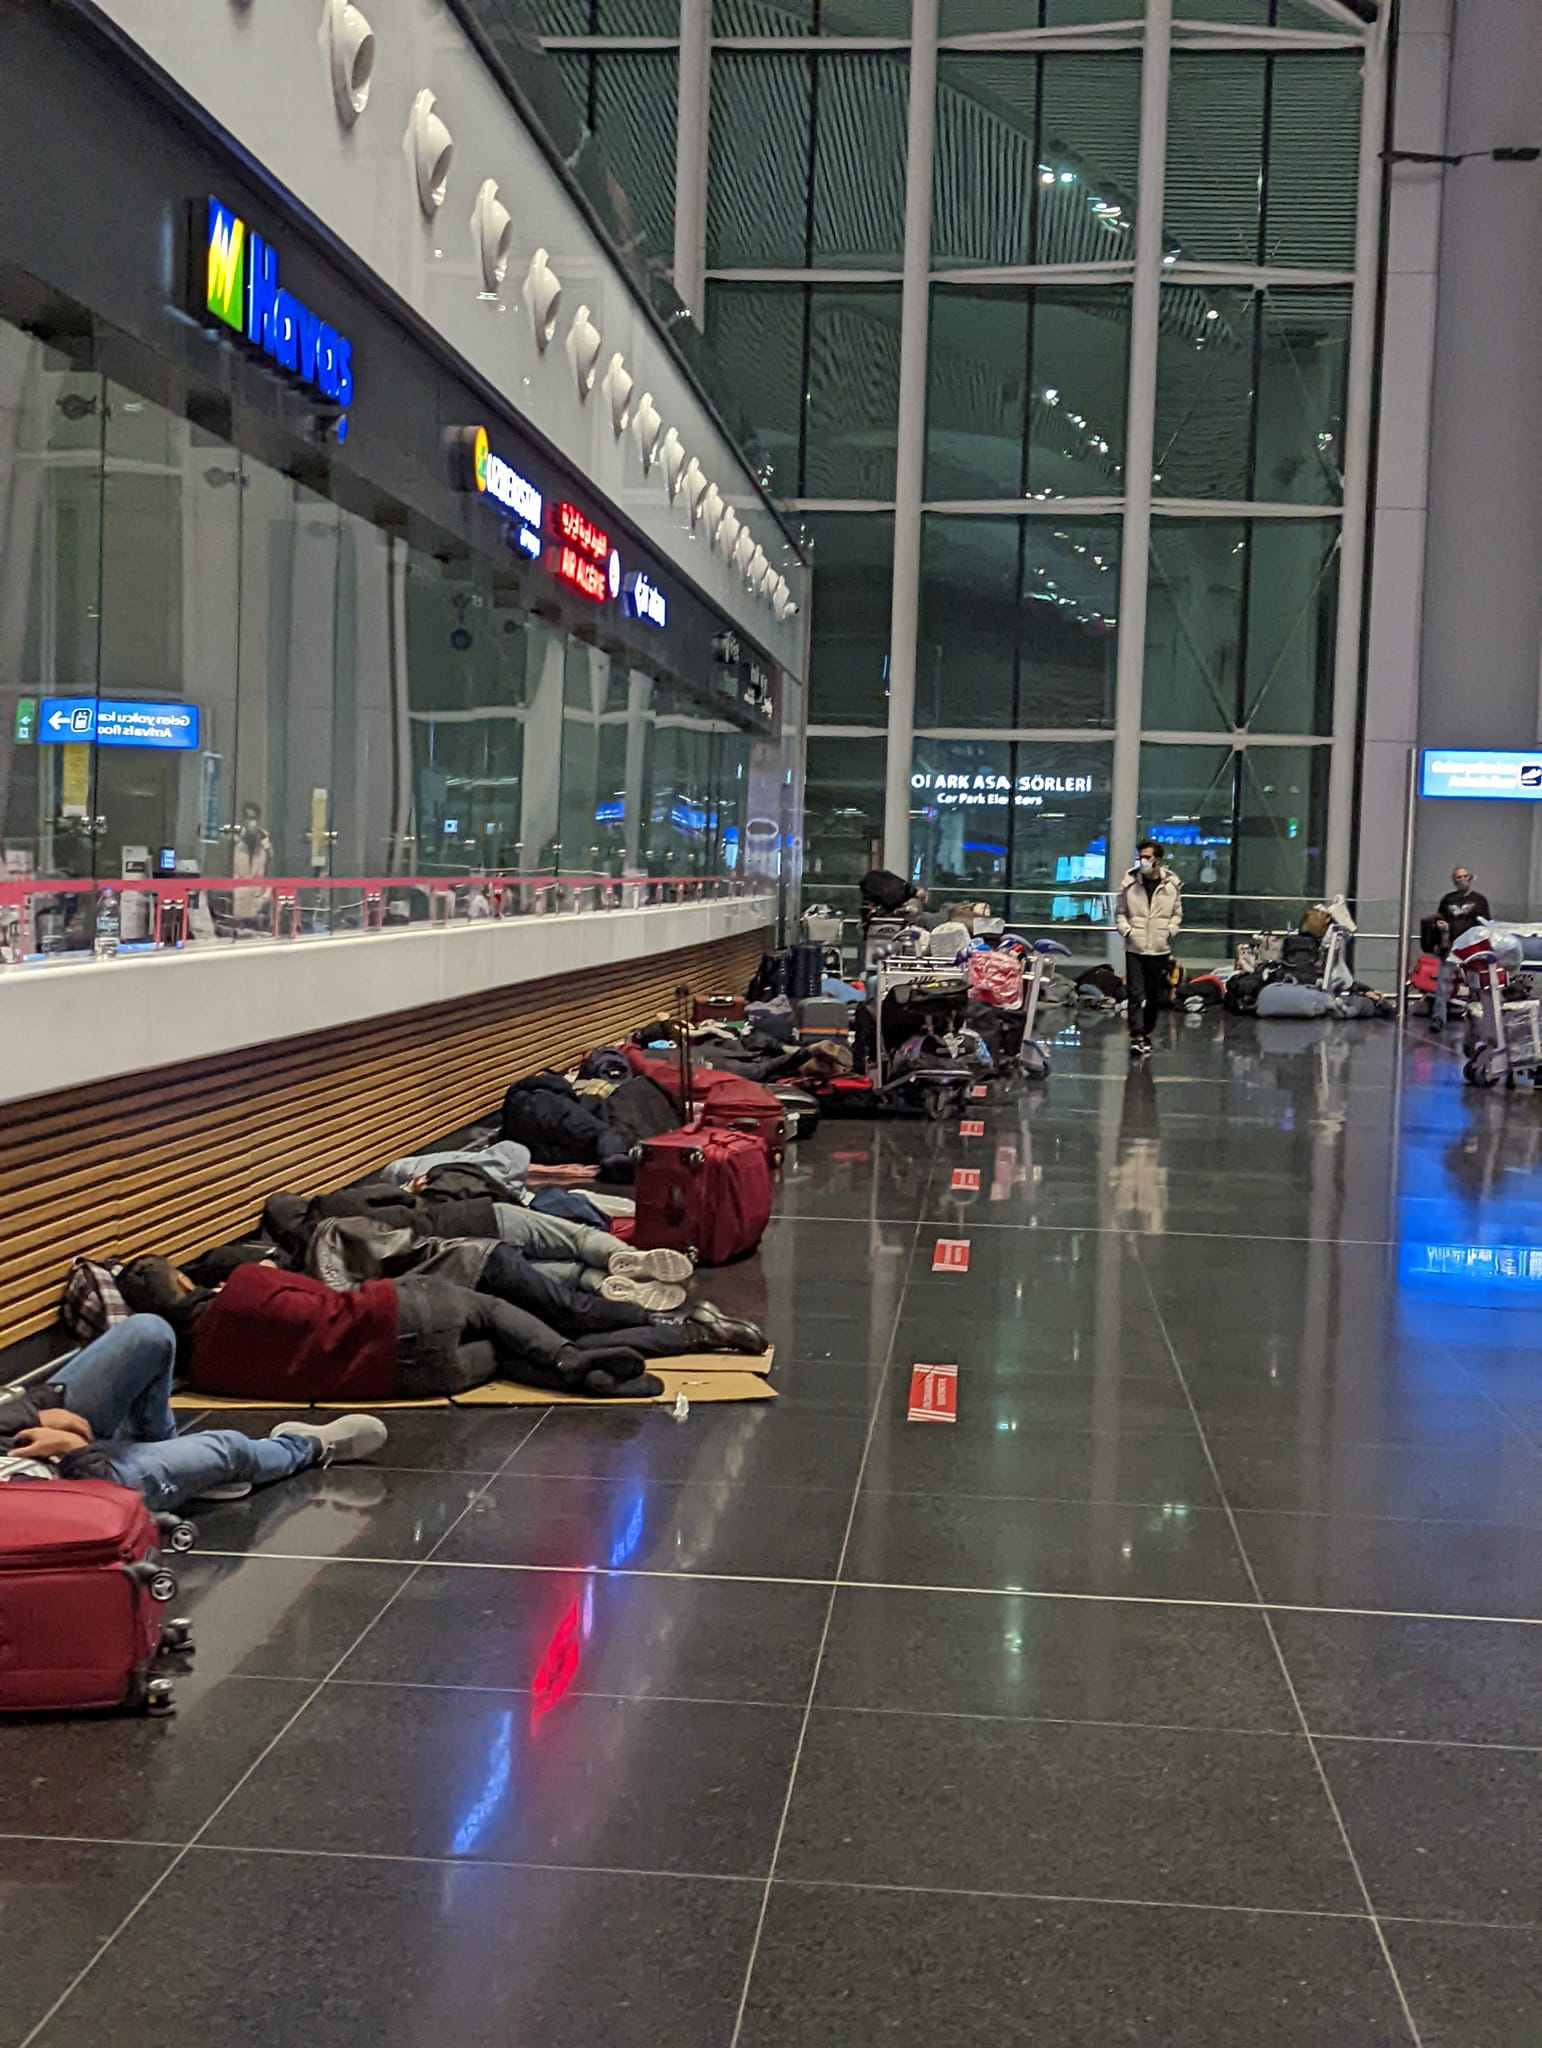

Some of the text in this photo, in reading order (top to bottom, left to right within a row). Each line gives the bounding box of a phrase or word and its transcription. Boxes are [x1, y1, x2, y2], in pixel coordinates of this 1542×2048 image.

[973, 774, 1092, 792] ASASÖRLERİ
[937, 793, 957, 804] Car
[959, 793, 985, 804] Park
